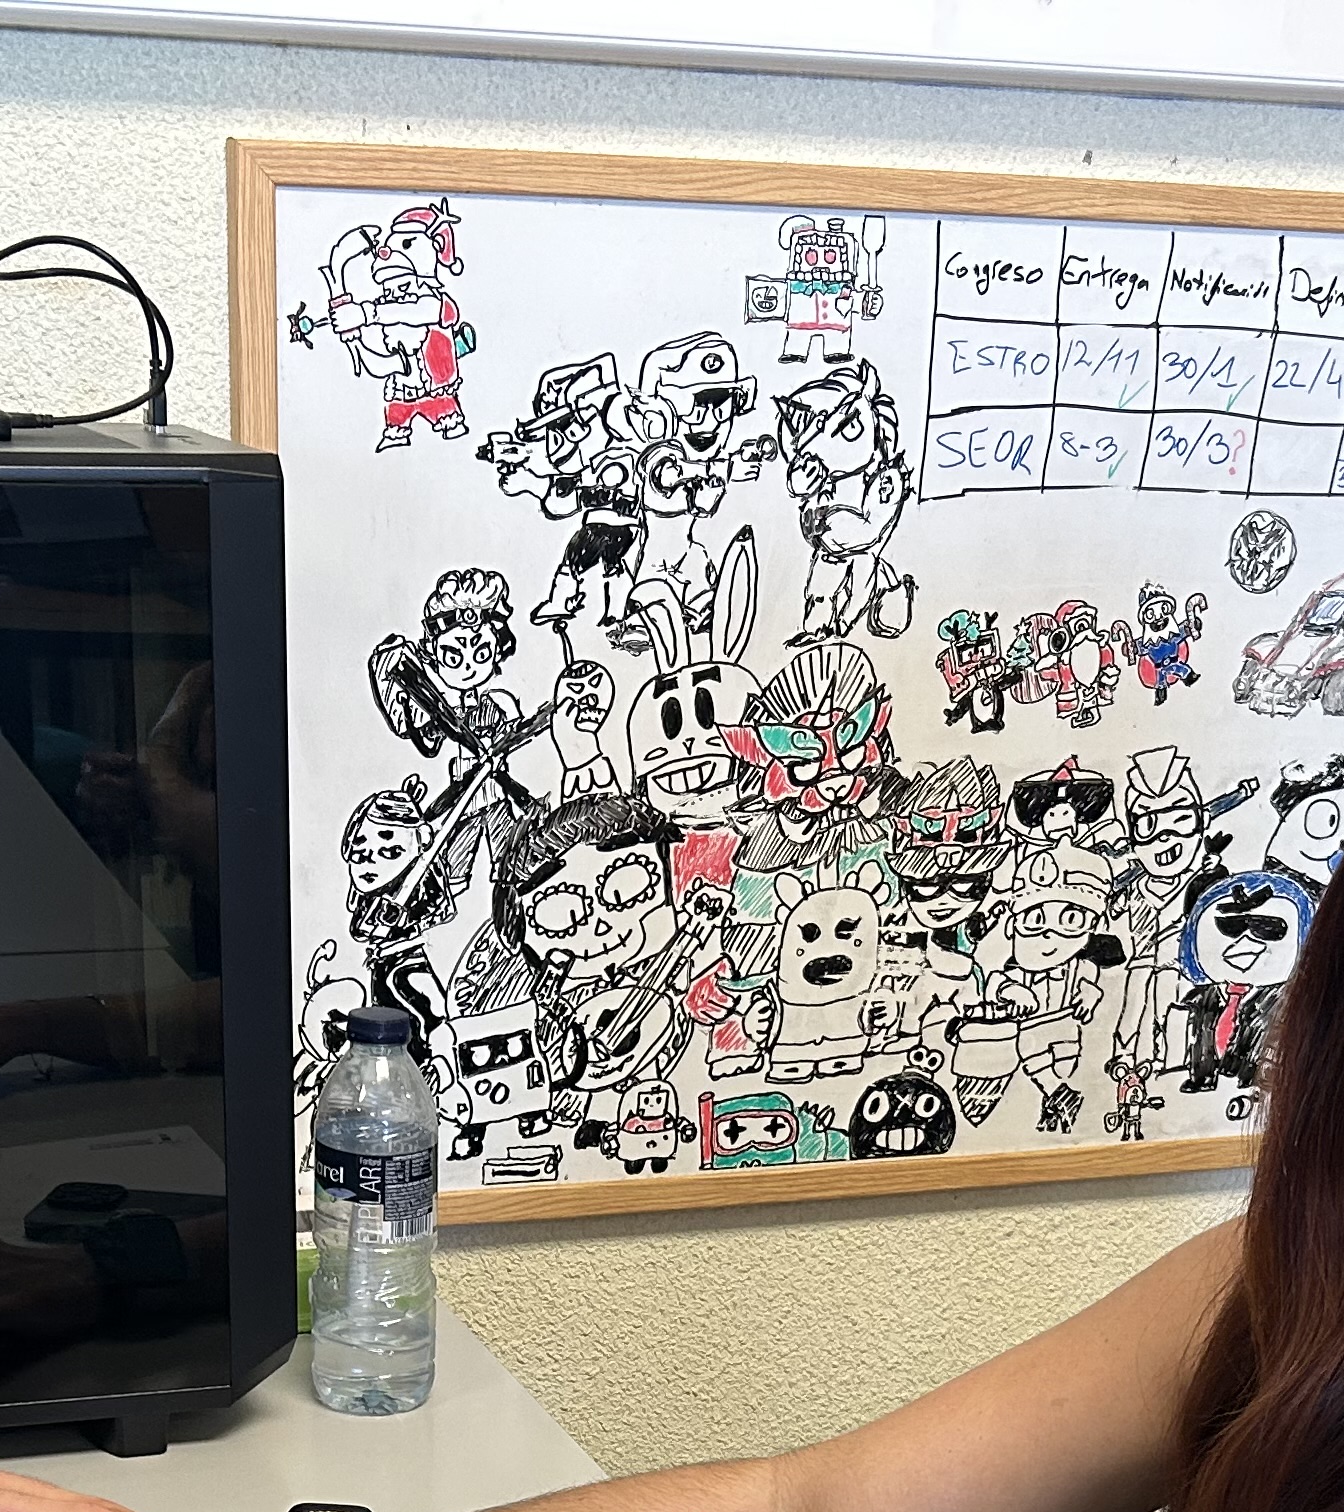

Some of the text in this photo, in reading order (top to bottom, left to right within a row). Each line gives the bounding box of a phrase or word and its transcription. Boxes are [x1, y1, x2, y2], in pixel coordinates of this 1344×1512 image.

[1060, 254, 1149, 309] Entrega
[947, 340, 1050, 377] ESTRO
[1062, 338, 1139, 376] 12/11
[1162, 346, 1237, 394] 30/1
[1271, 348, 1343, 399] 22/4
[936, 427, 1033, 475] SEOR
